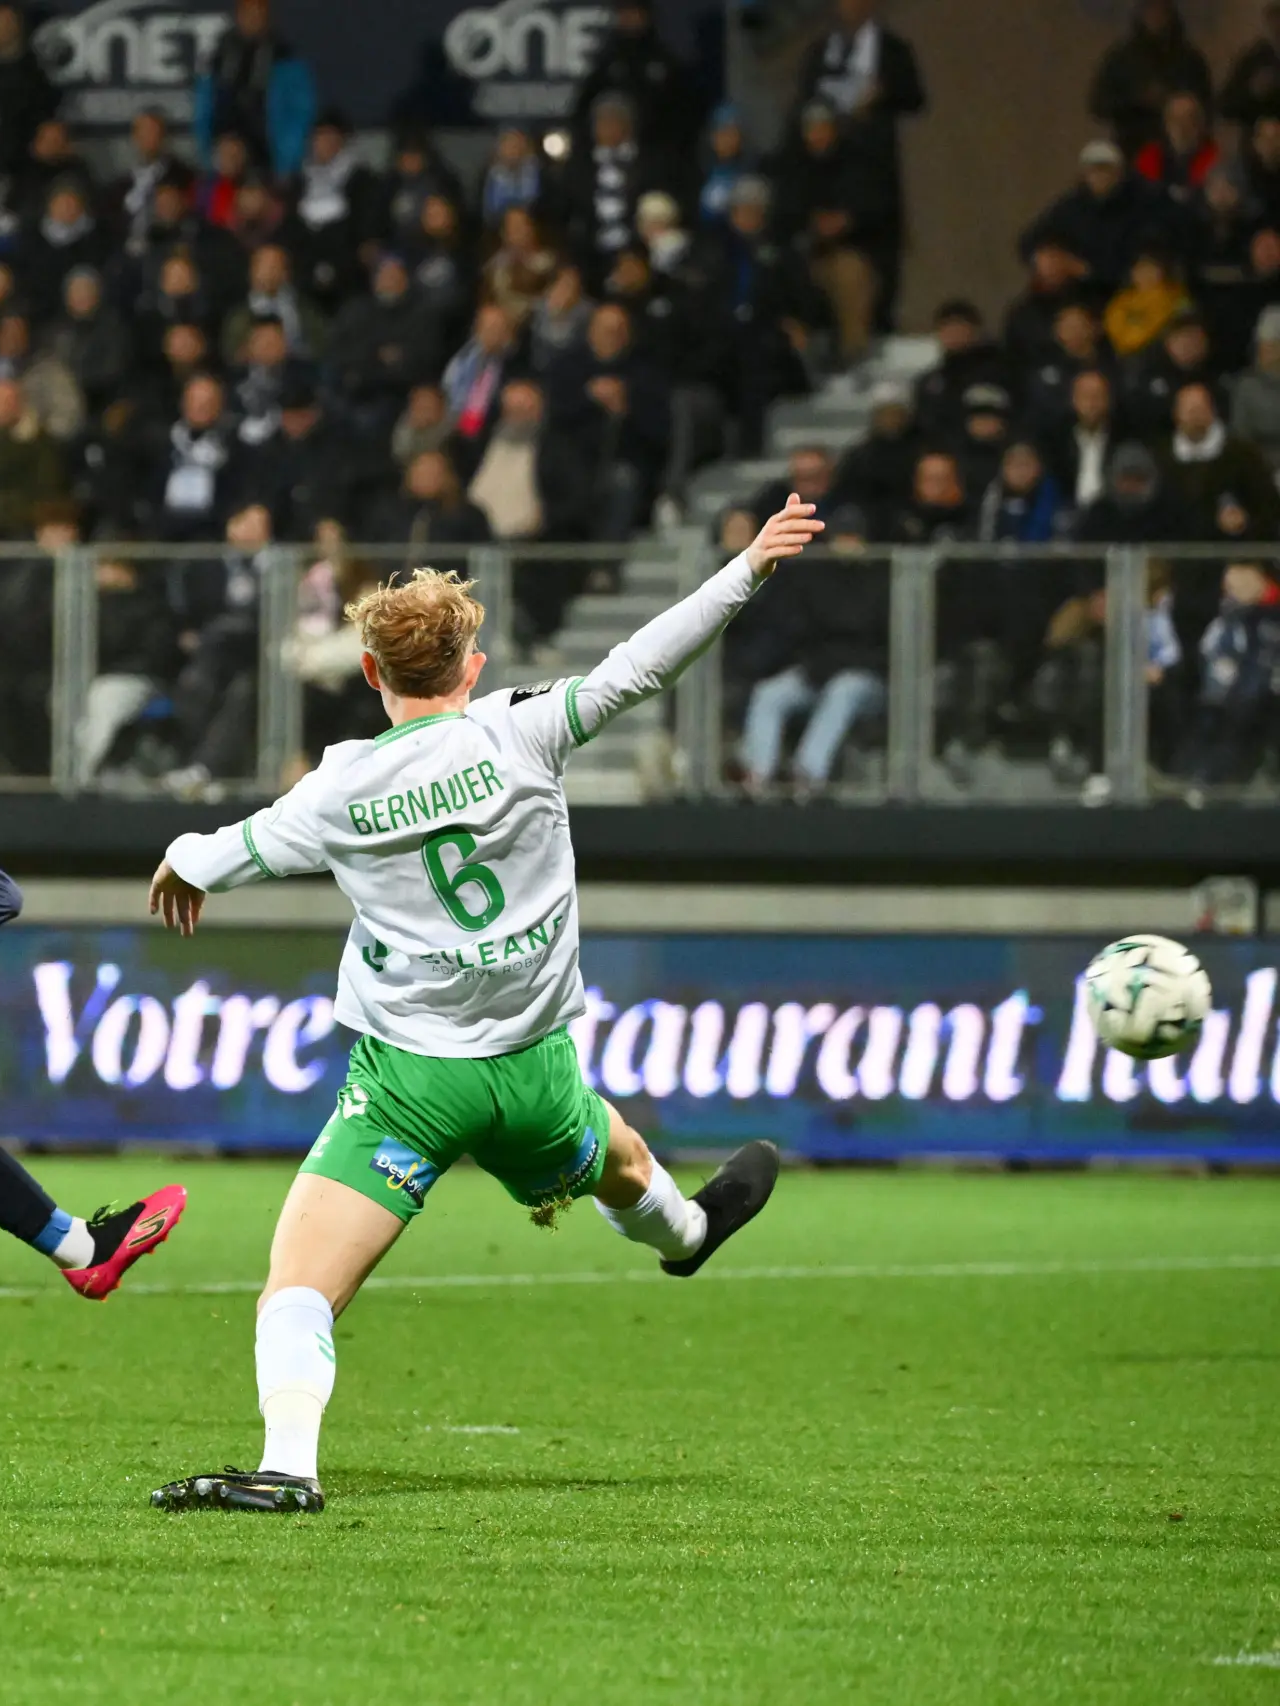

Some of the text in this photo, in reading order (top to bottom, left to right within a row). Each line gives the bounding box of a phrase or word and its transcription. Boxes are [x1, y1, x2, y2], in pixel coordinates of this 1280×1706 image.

[349, 759, 504, 835] BERNAUER
[422, 824, 505, 932] 6
[33, 960, 338, 1093] Votre
[570, 985, 1044, 1100] taurant
